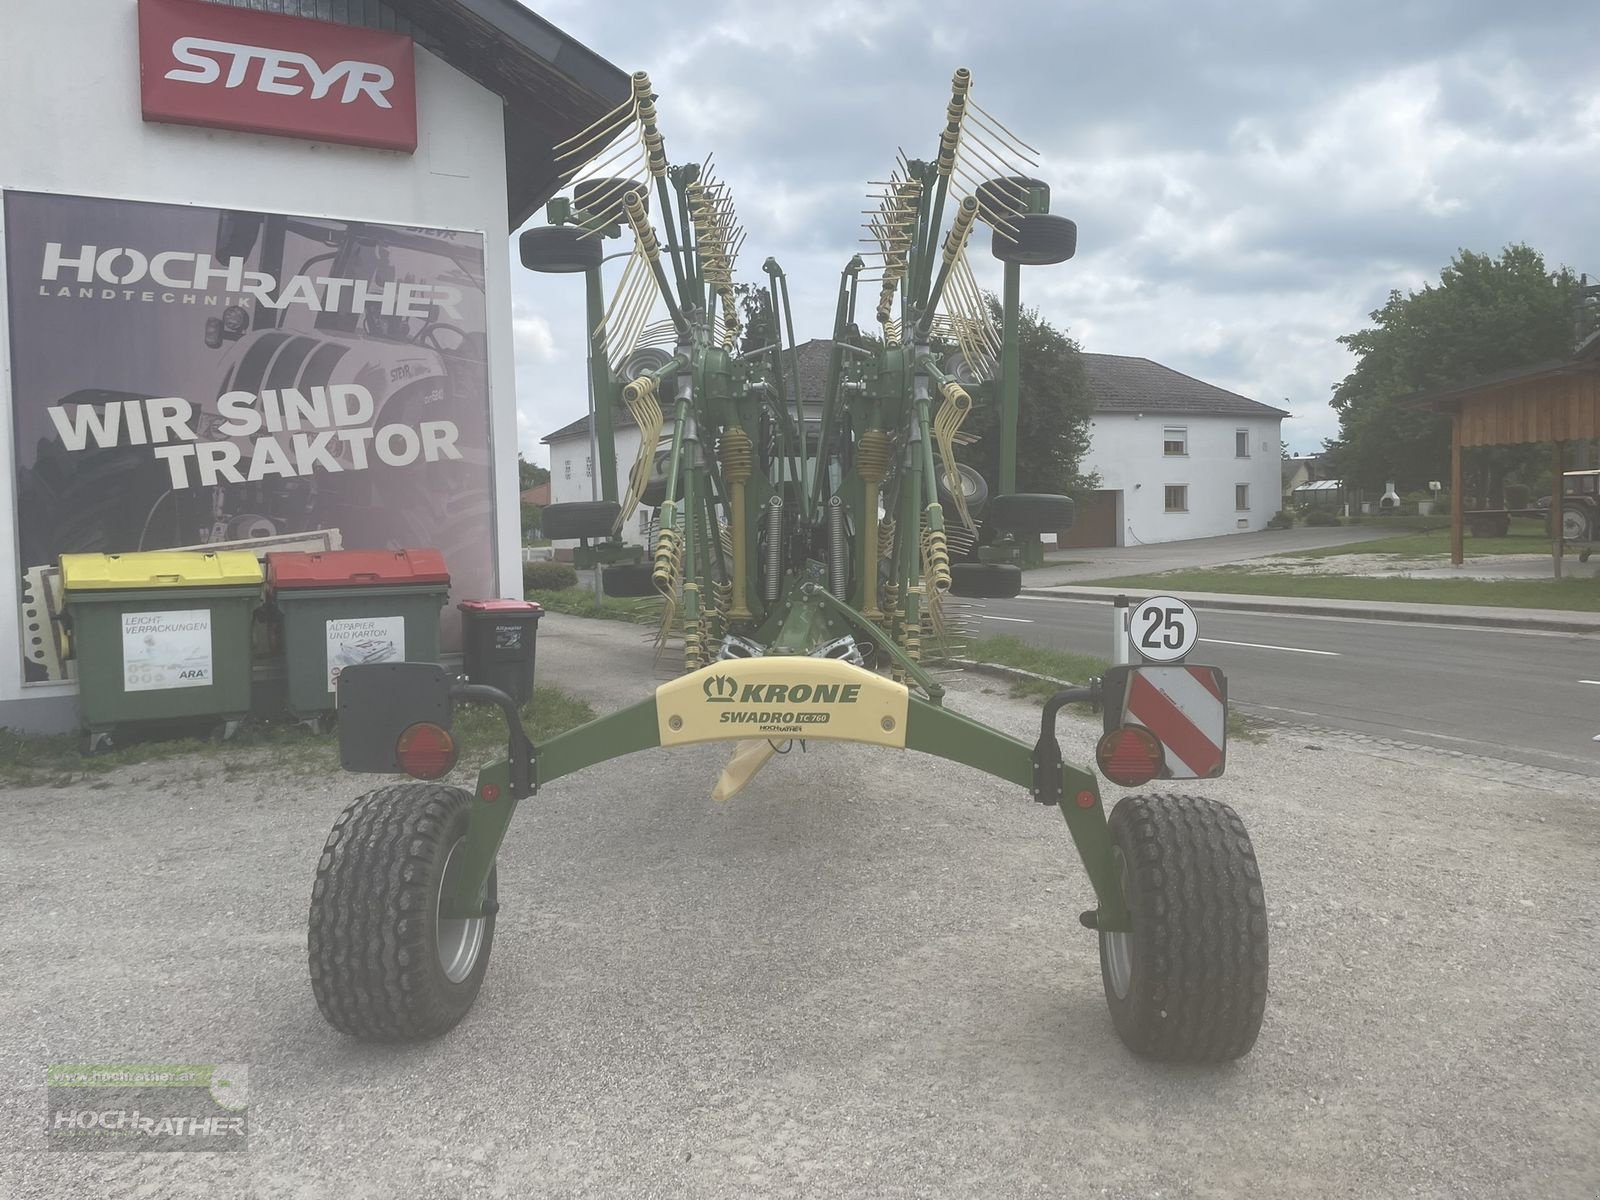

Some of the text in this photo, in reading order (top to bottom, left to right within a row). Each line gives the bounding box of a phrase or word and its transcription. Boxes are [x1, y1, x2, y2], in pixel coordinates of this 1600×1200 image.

[164, 36, 395, 109] STEYR
[41, 242, 463, 320] HOCHRATHER
[39, 285, 250, 307] LANDTECHNIK
[47, 383, 374, 451] WIR SIND
[154, 420, 463, 490] TRAKTOR
[125, 622, 208, 635] VERPACKUNGEN
[329, 629, 388, 640] UND KARTON
[330, 621, 376, 632] ALTPAPIER
[1141, 606, 1185, 650] 25
[739, 684, 862, 704] KRONE
[719, 711, 827, 724] SWADRO TC 760
